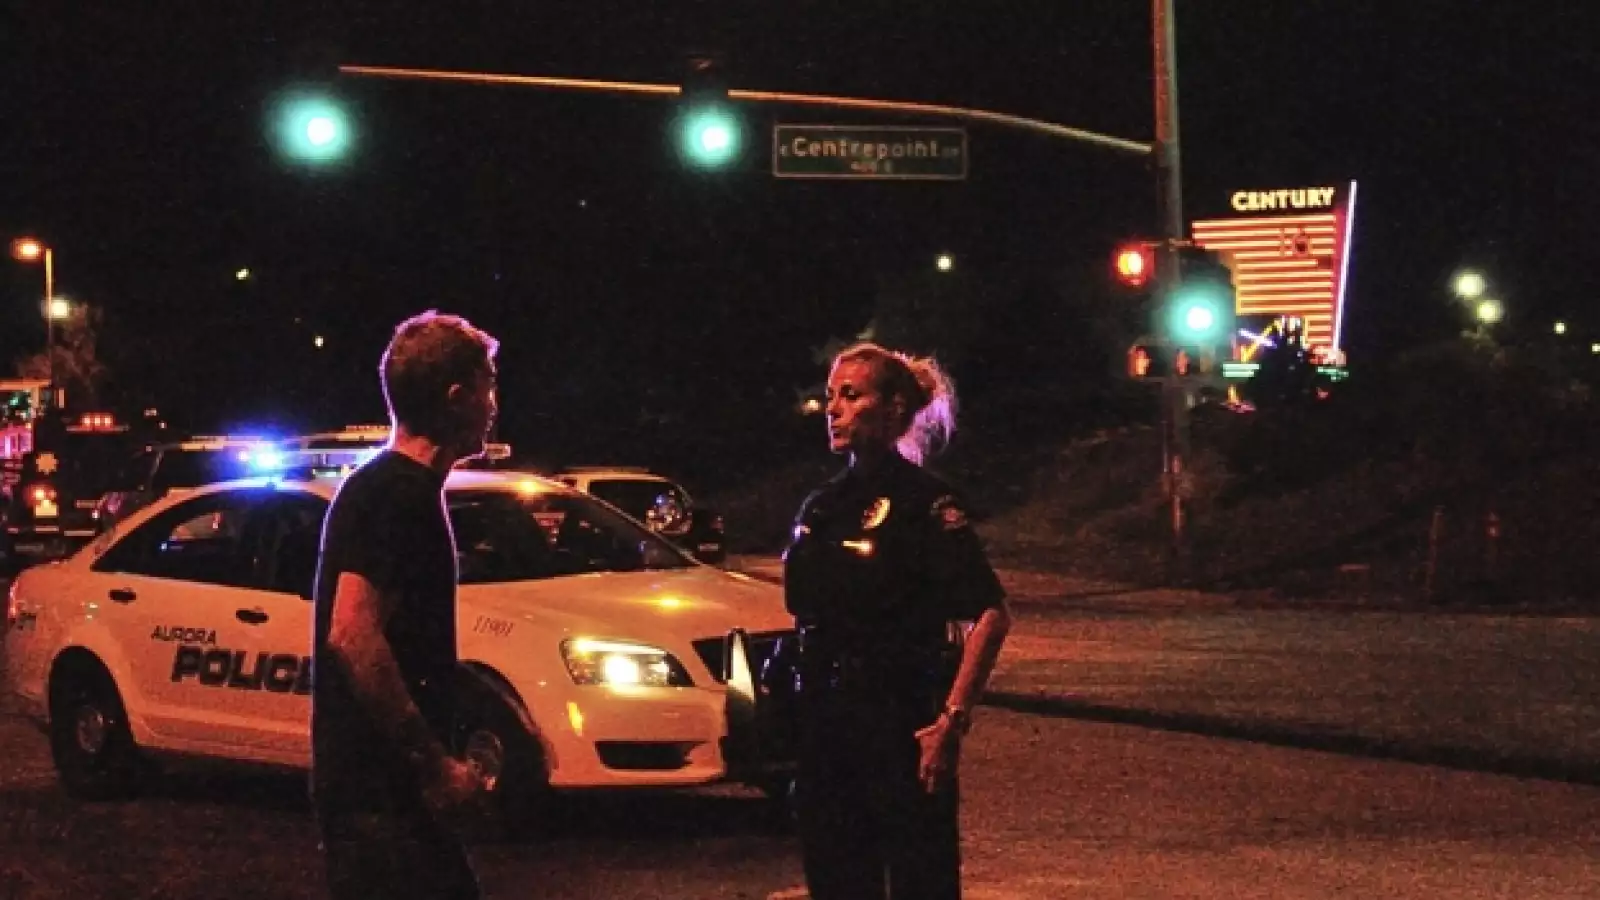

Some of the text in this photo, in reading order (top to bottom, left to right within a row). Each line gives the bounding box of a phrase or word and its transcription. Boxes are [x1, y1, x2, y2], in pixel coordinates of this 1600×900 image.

[792, 137, 938, 160] Centrepoint
[1231, 187, 1336, 211] CENTURY
[151, 625, 217, 645] AURORA
